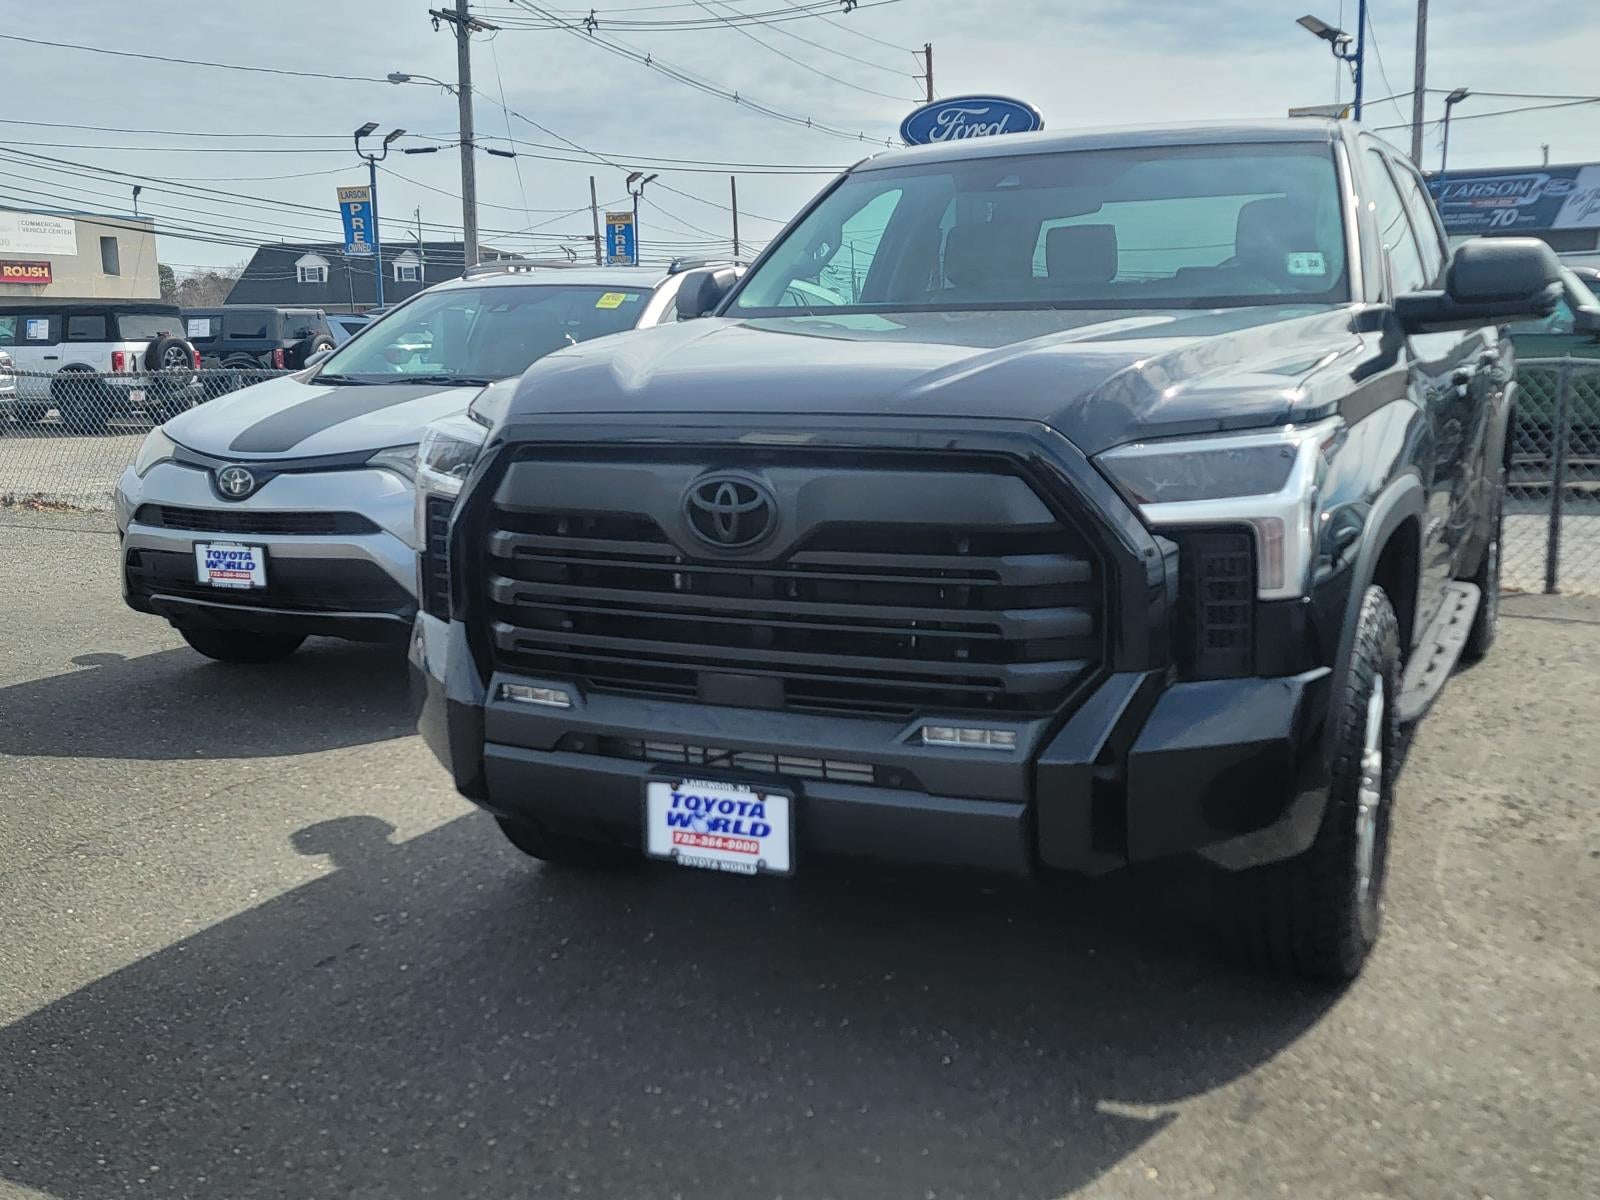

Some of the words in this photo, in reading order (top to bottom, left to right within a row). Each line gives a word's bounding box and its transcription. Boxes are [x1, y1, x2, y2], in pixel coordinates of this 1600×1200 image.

[929, 107, 1010, 143] Ford
[340, 190, 367, 199] LARSON
[1442, 180, 1532, 198] LARSON
[20, 220, 62, 228] COMMERCIAL
[1488, 208, 1519, 227] 70
[348, 242, 372, 252] OWNED
[3, 266, 49, 277] ROUSH
[205, 550, 252, 560] TOYOTA
[205, 560, 256, 570] WORLD
[671, 792, 765, 818] TOYOTA
[667, 811, 772, 837] WORLD
[677, 855, 719, 870] TOYOTA
[720, 859, 757, 874] WORLD
